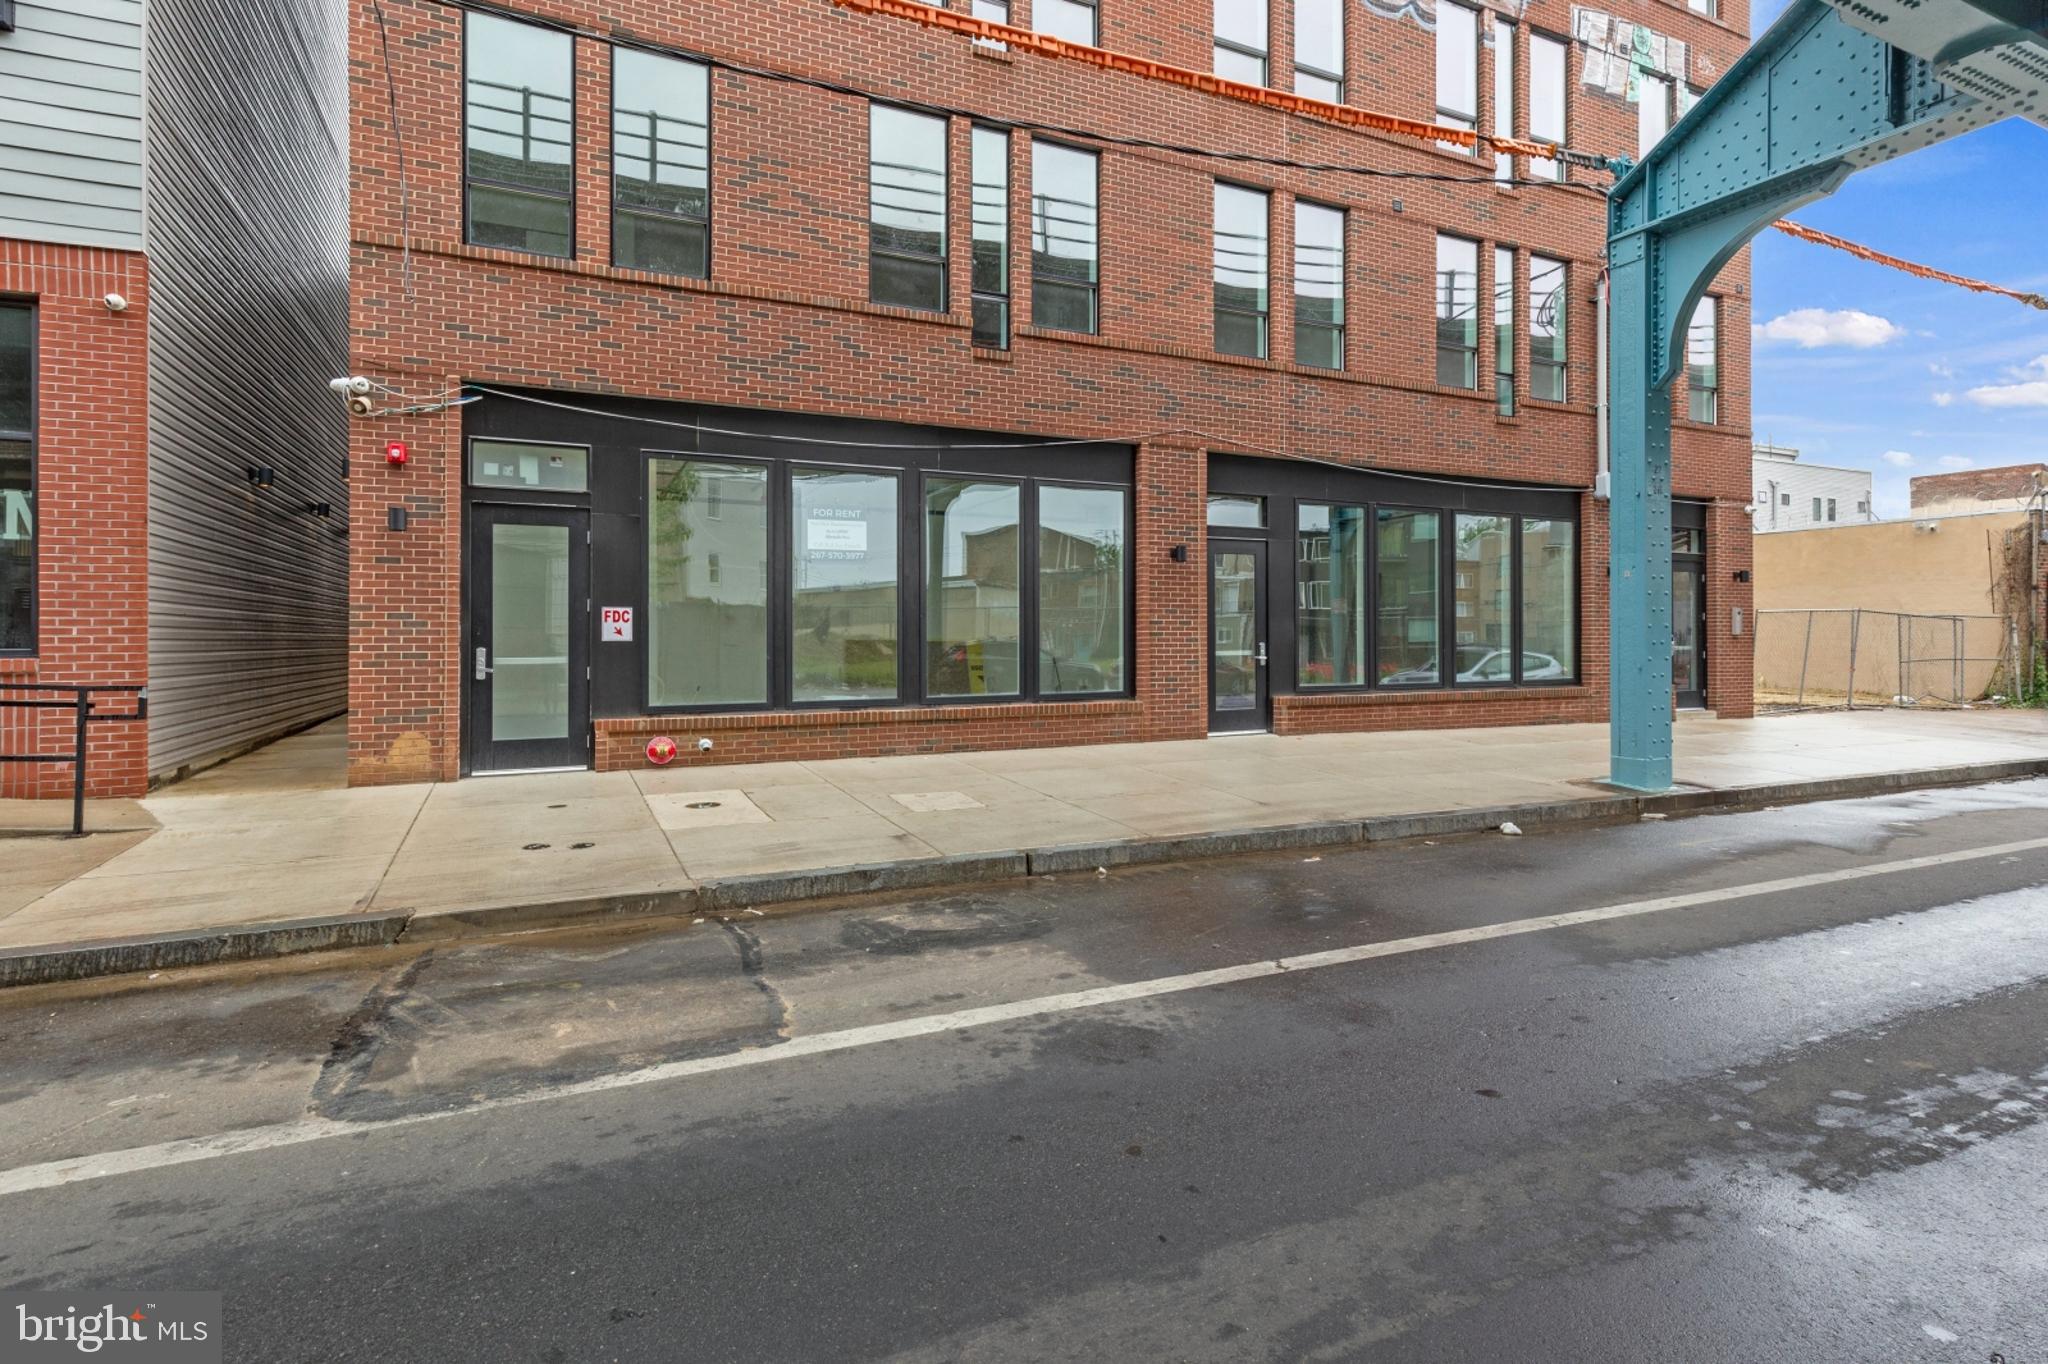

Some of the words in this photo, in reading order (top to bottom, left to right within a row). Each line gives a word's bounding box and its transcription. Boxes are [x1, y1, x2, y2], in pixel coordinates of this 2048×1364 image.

[813, 508, 833, 518] FOR
[835, 509, 862, 519] RENT
[604, 610, 630, 623] FDC
